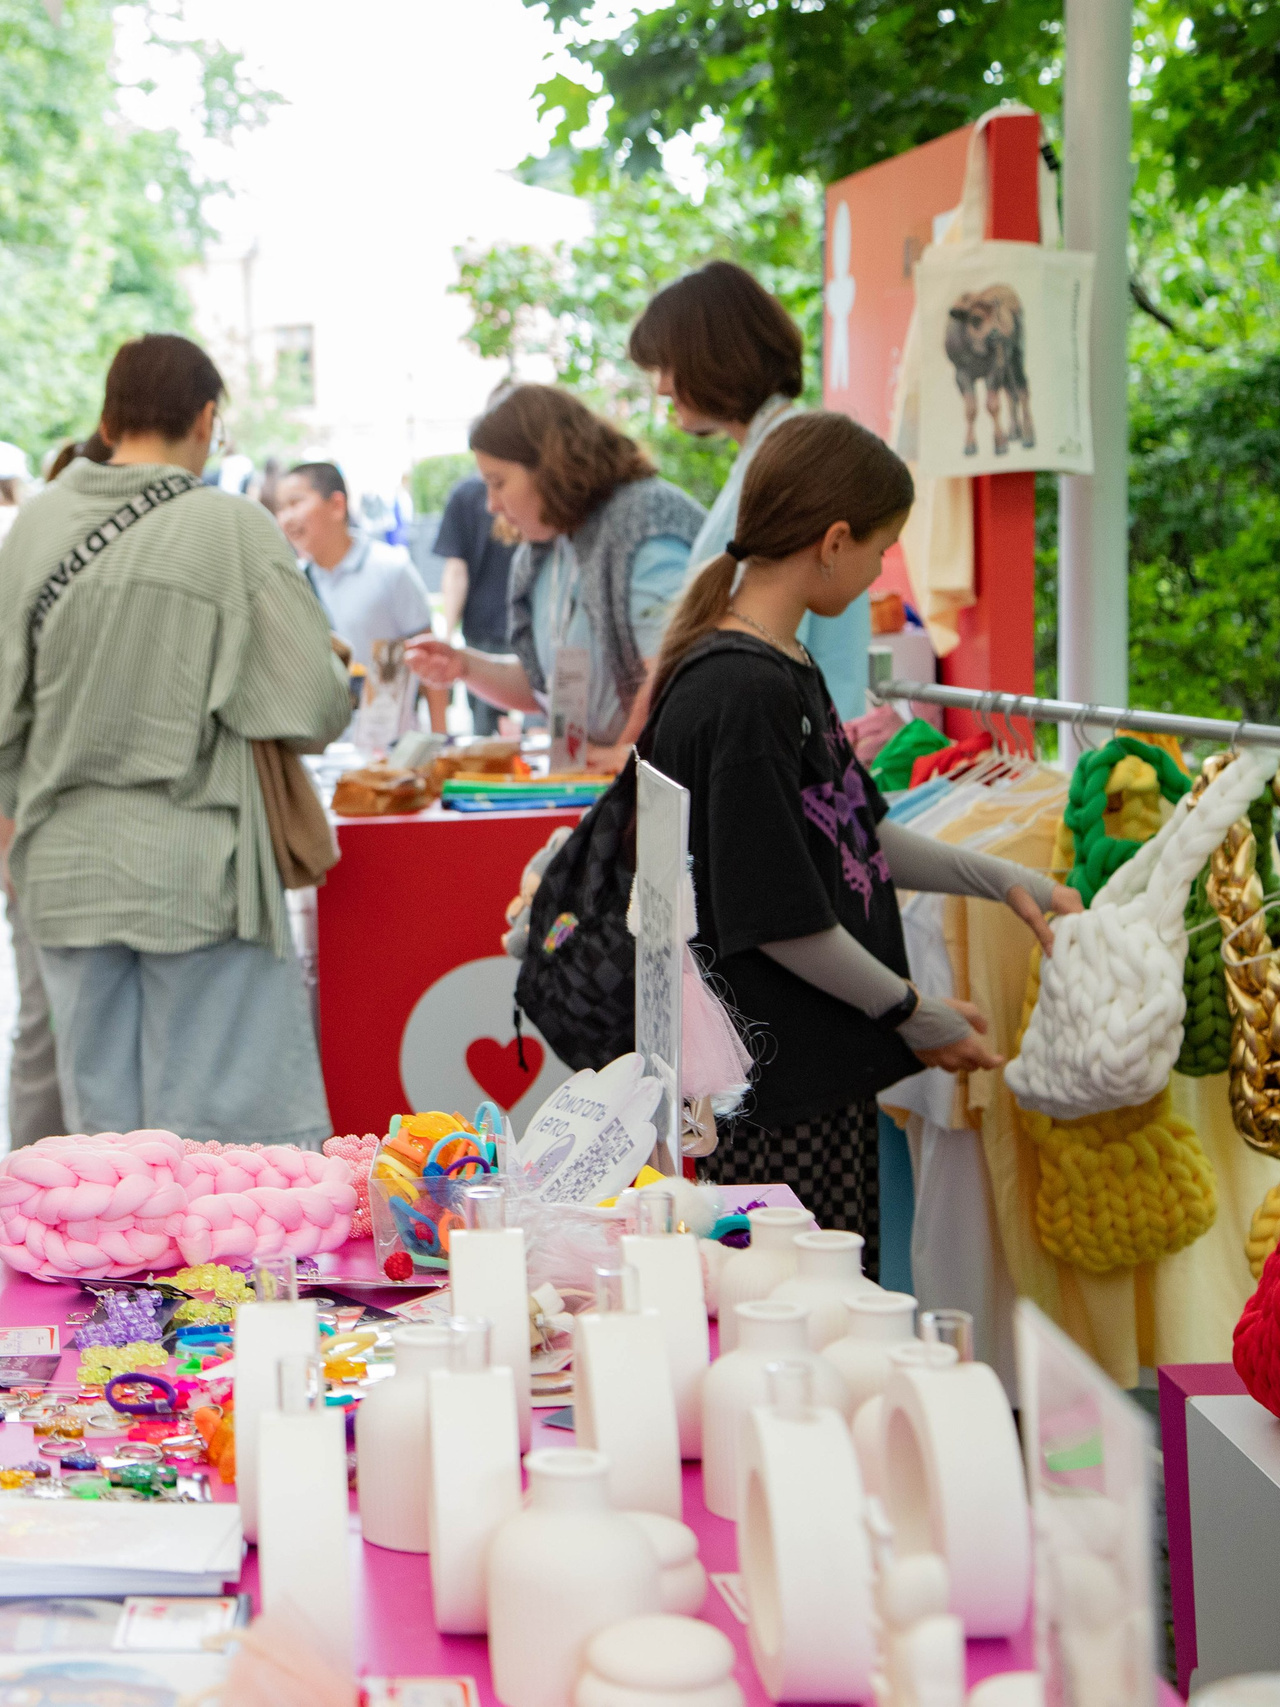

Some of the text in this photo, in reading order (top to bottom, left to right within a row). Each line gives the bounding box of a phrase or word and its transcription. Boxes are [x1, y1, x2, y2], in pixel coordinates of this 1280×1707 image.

[85, 474, 202, 554] ERFELD
[548, 1085, 608, 1122] Помогать
[532, 1115, 570, 1138] легко
